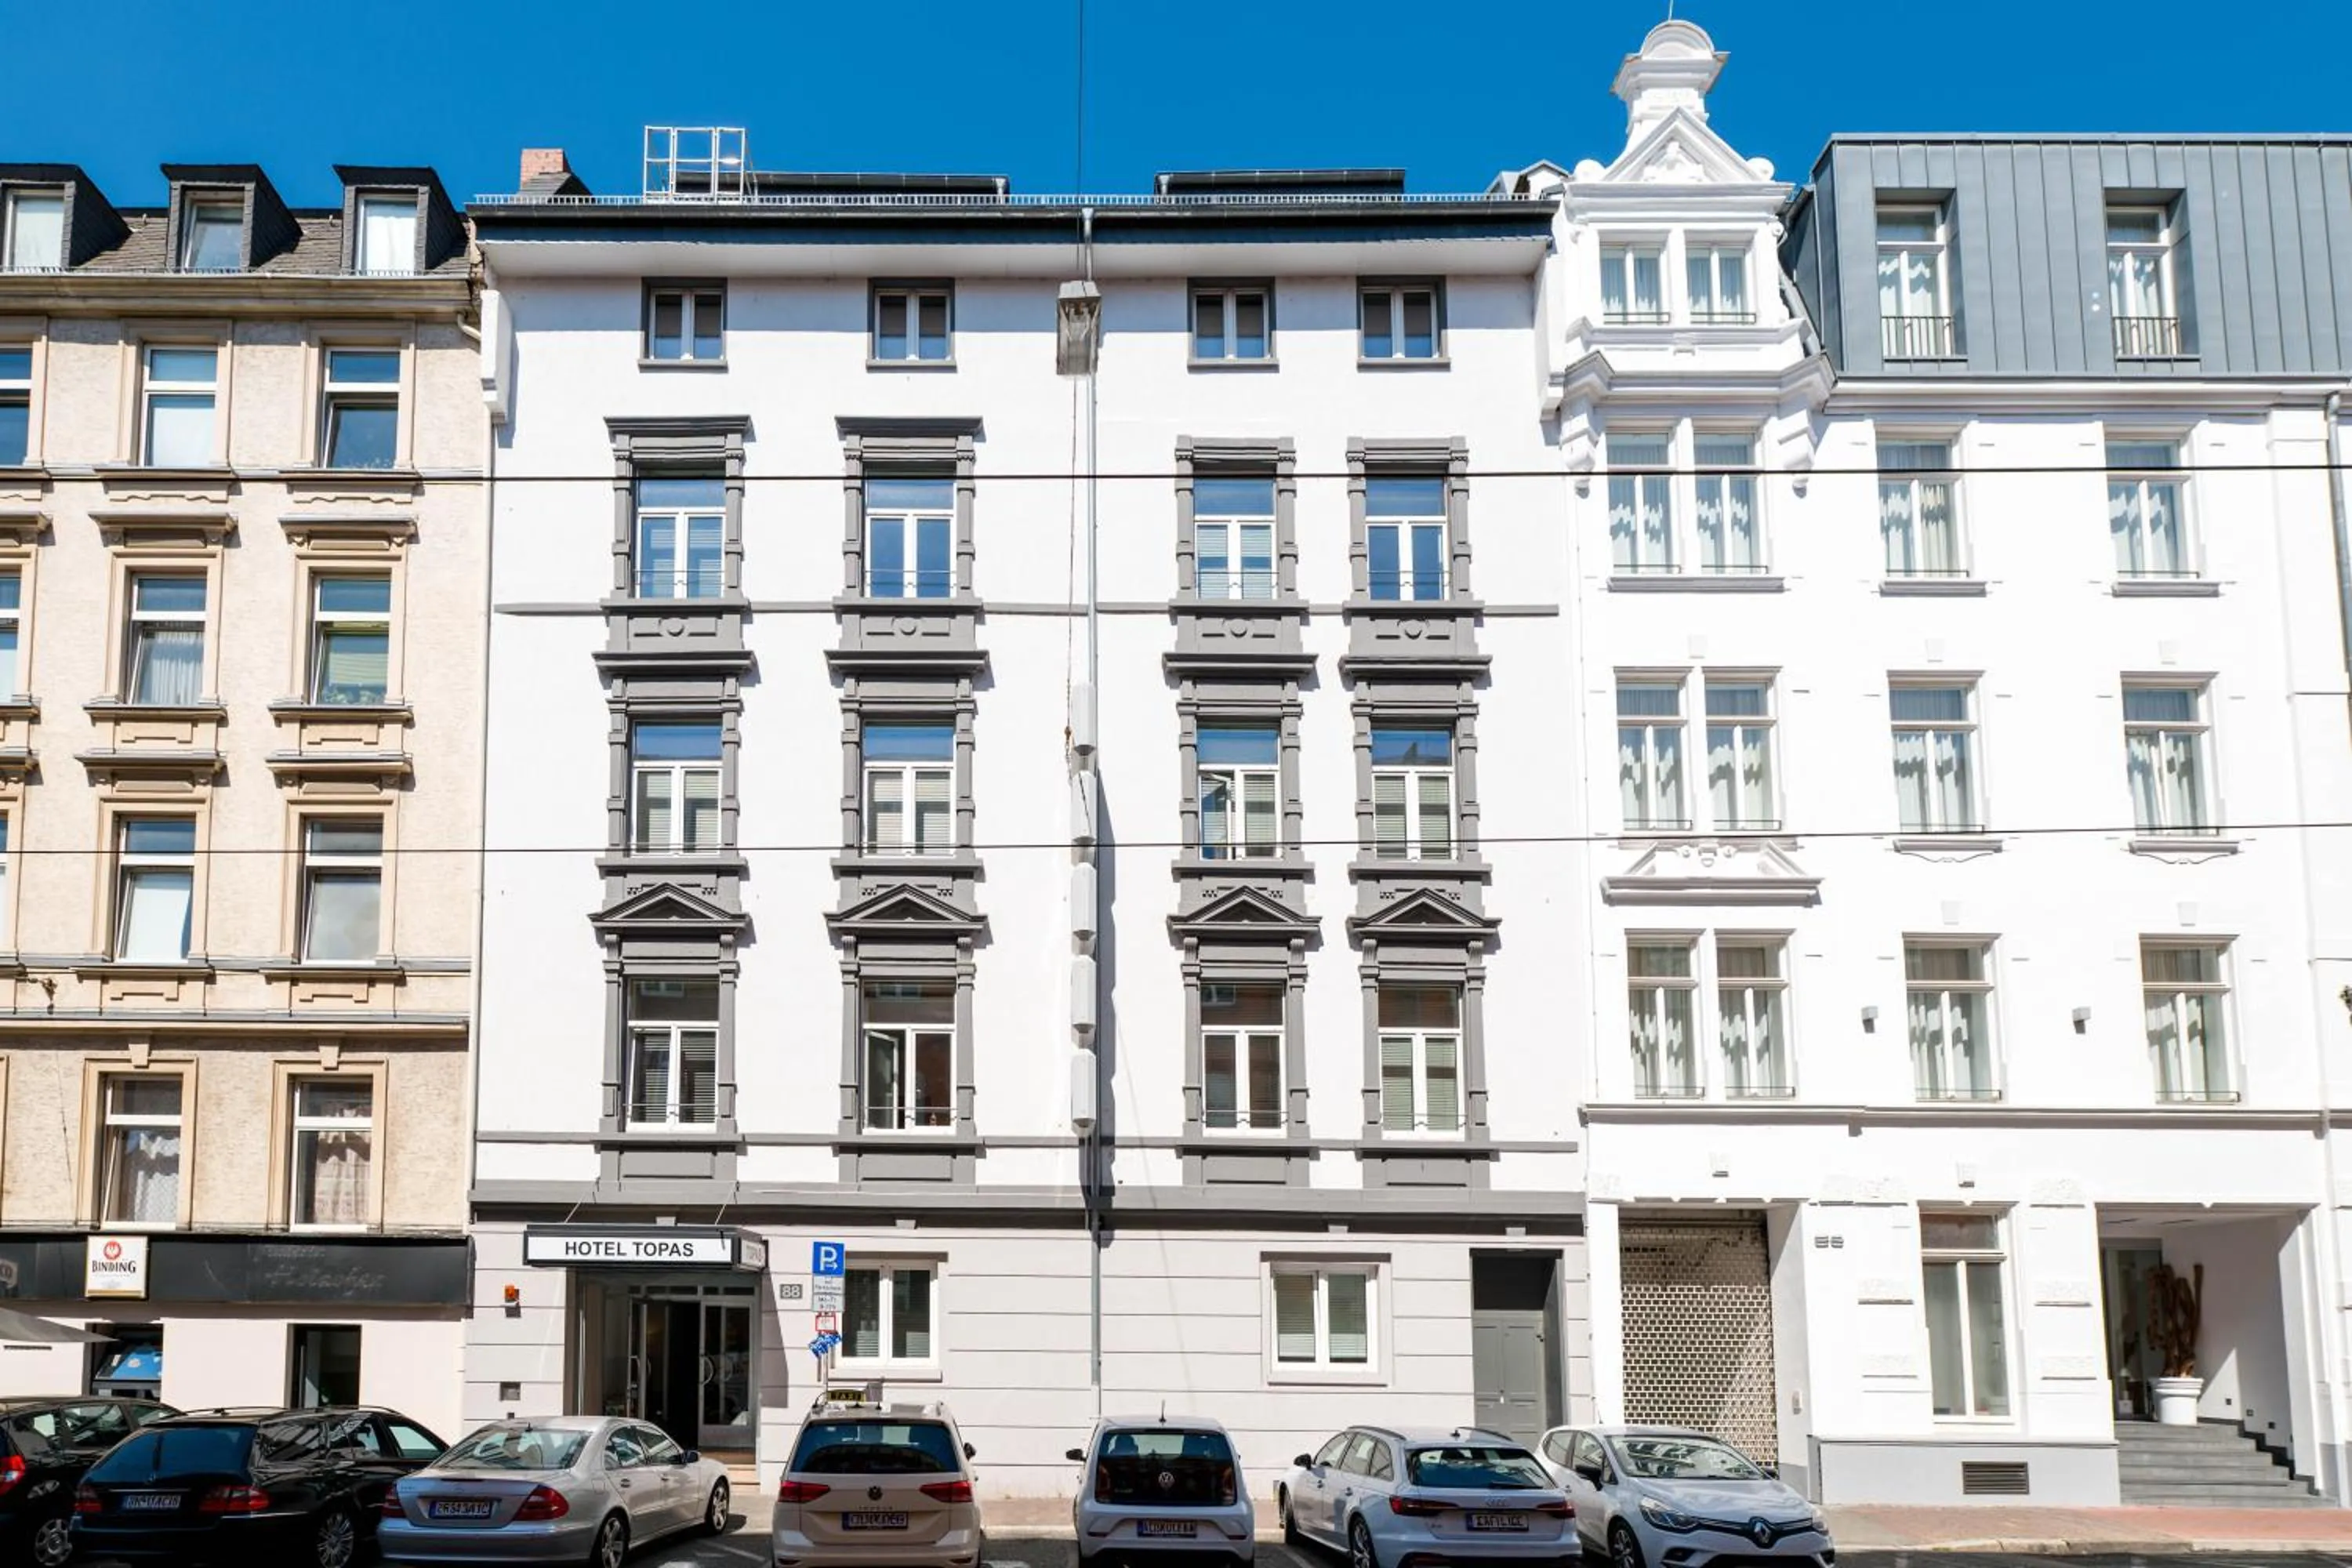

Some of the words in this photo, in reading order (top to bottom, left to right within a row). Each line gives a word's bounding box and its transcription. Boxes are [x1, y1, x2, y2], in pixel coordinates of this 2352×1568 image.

[565, 1241, 627, 1256] HOTEL
[633, 1242, 694, 1257] TOPAS
[820, 1246, 837, 1271] P
[92, 1260, 136, 1273] BINDING
[782, 1286, 800, 1298] 88
